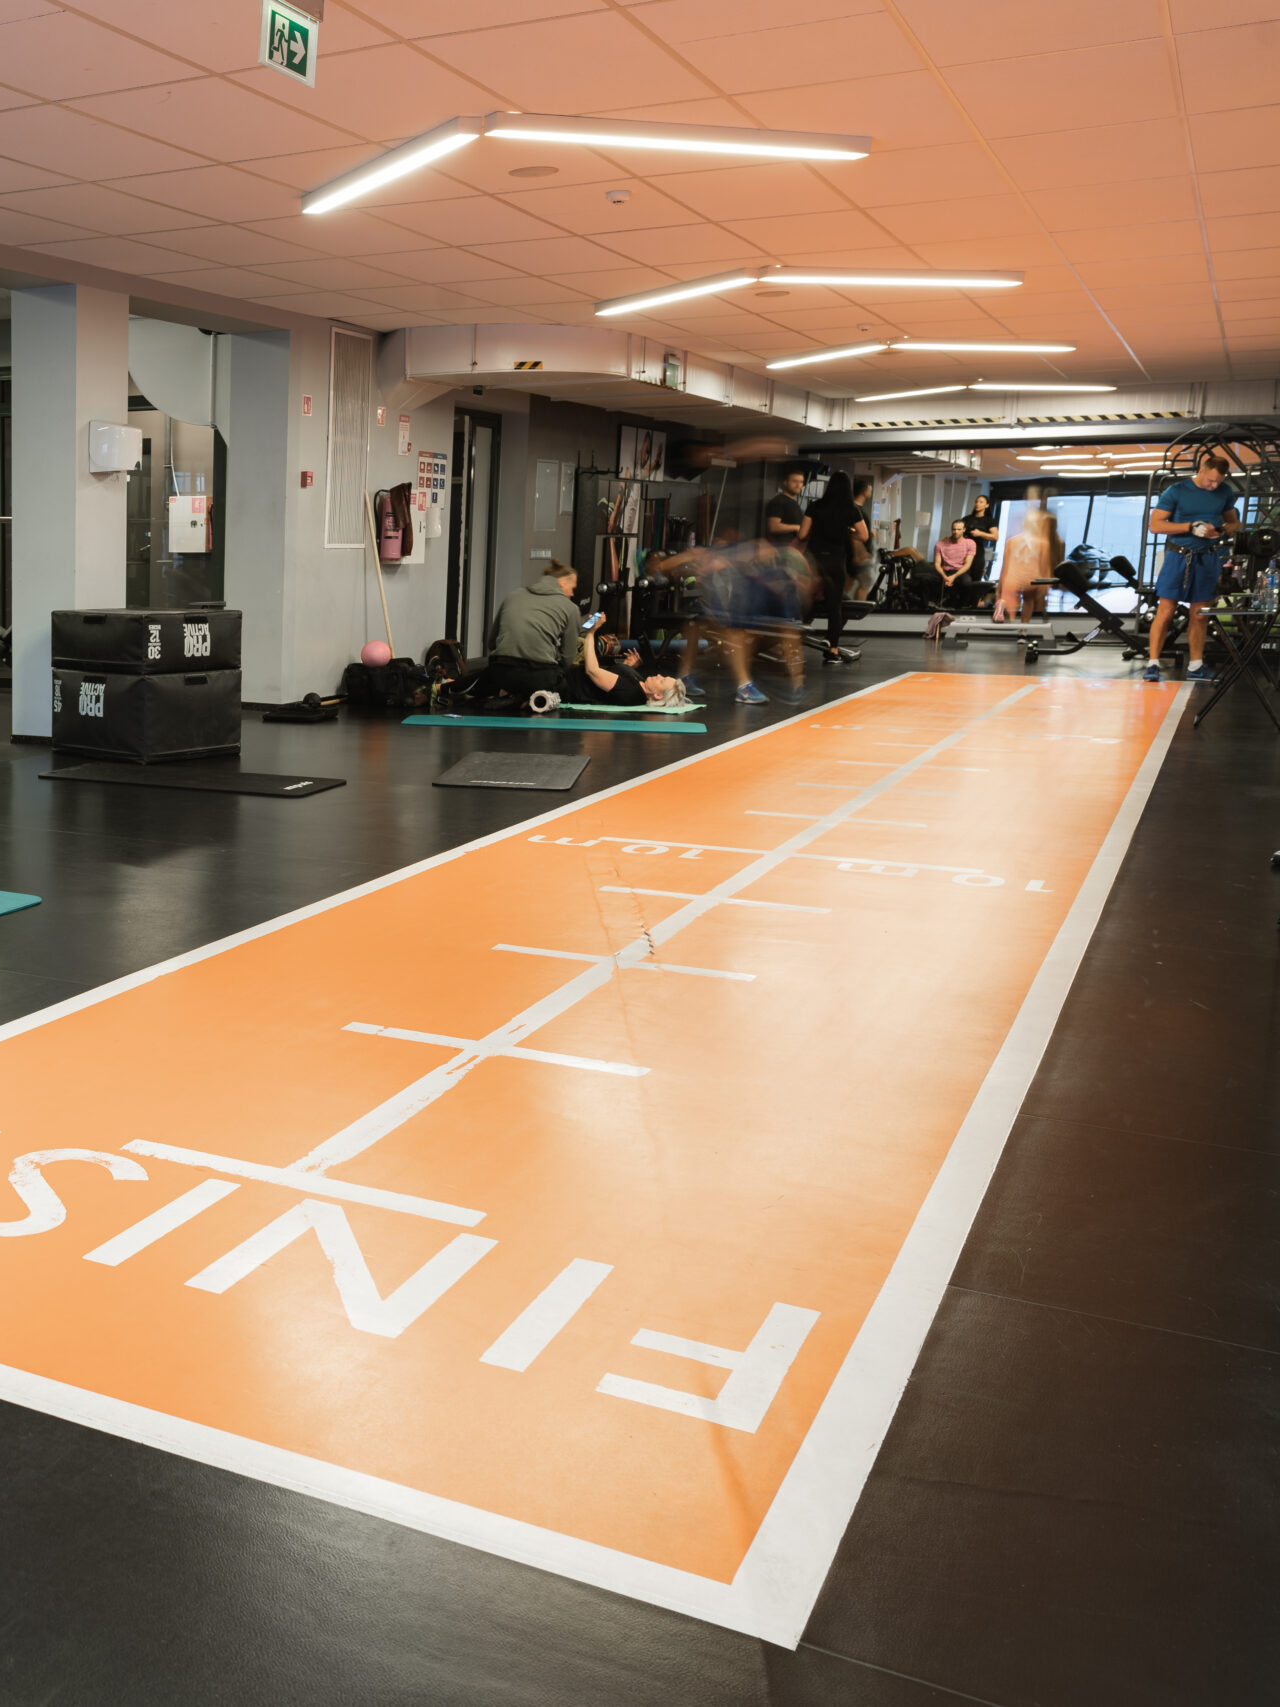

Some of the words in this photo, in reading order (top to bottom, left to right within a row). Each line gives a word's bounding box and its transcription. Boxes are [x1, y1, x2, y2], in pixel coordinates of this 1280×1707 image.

[149, 630, 160, 643] 12
[182, 623, 209, 637] ACTIVE
[184, 633, 211, 658] PRO
[148, 646, 161, 660] 30
[79, 682, 106, 696] ACTIVE
[78, 694, 104, 718] PRO
